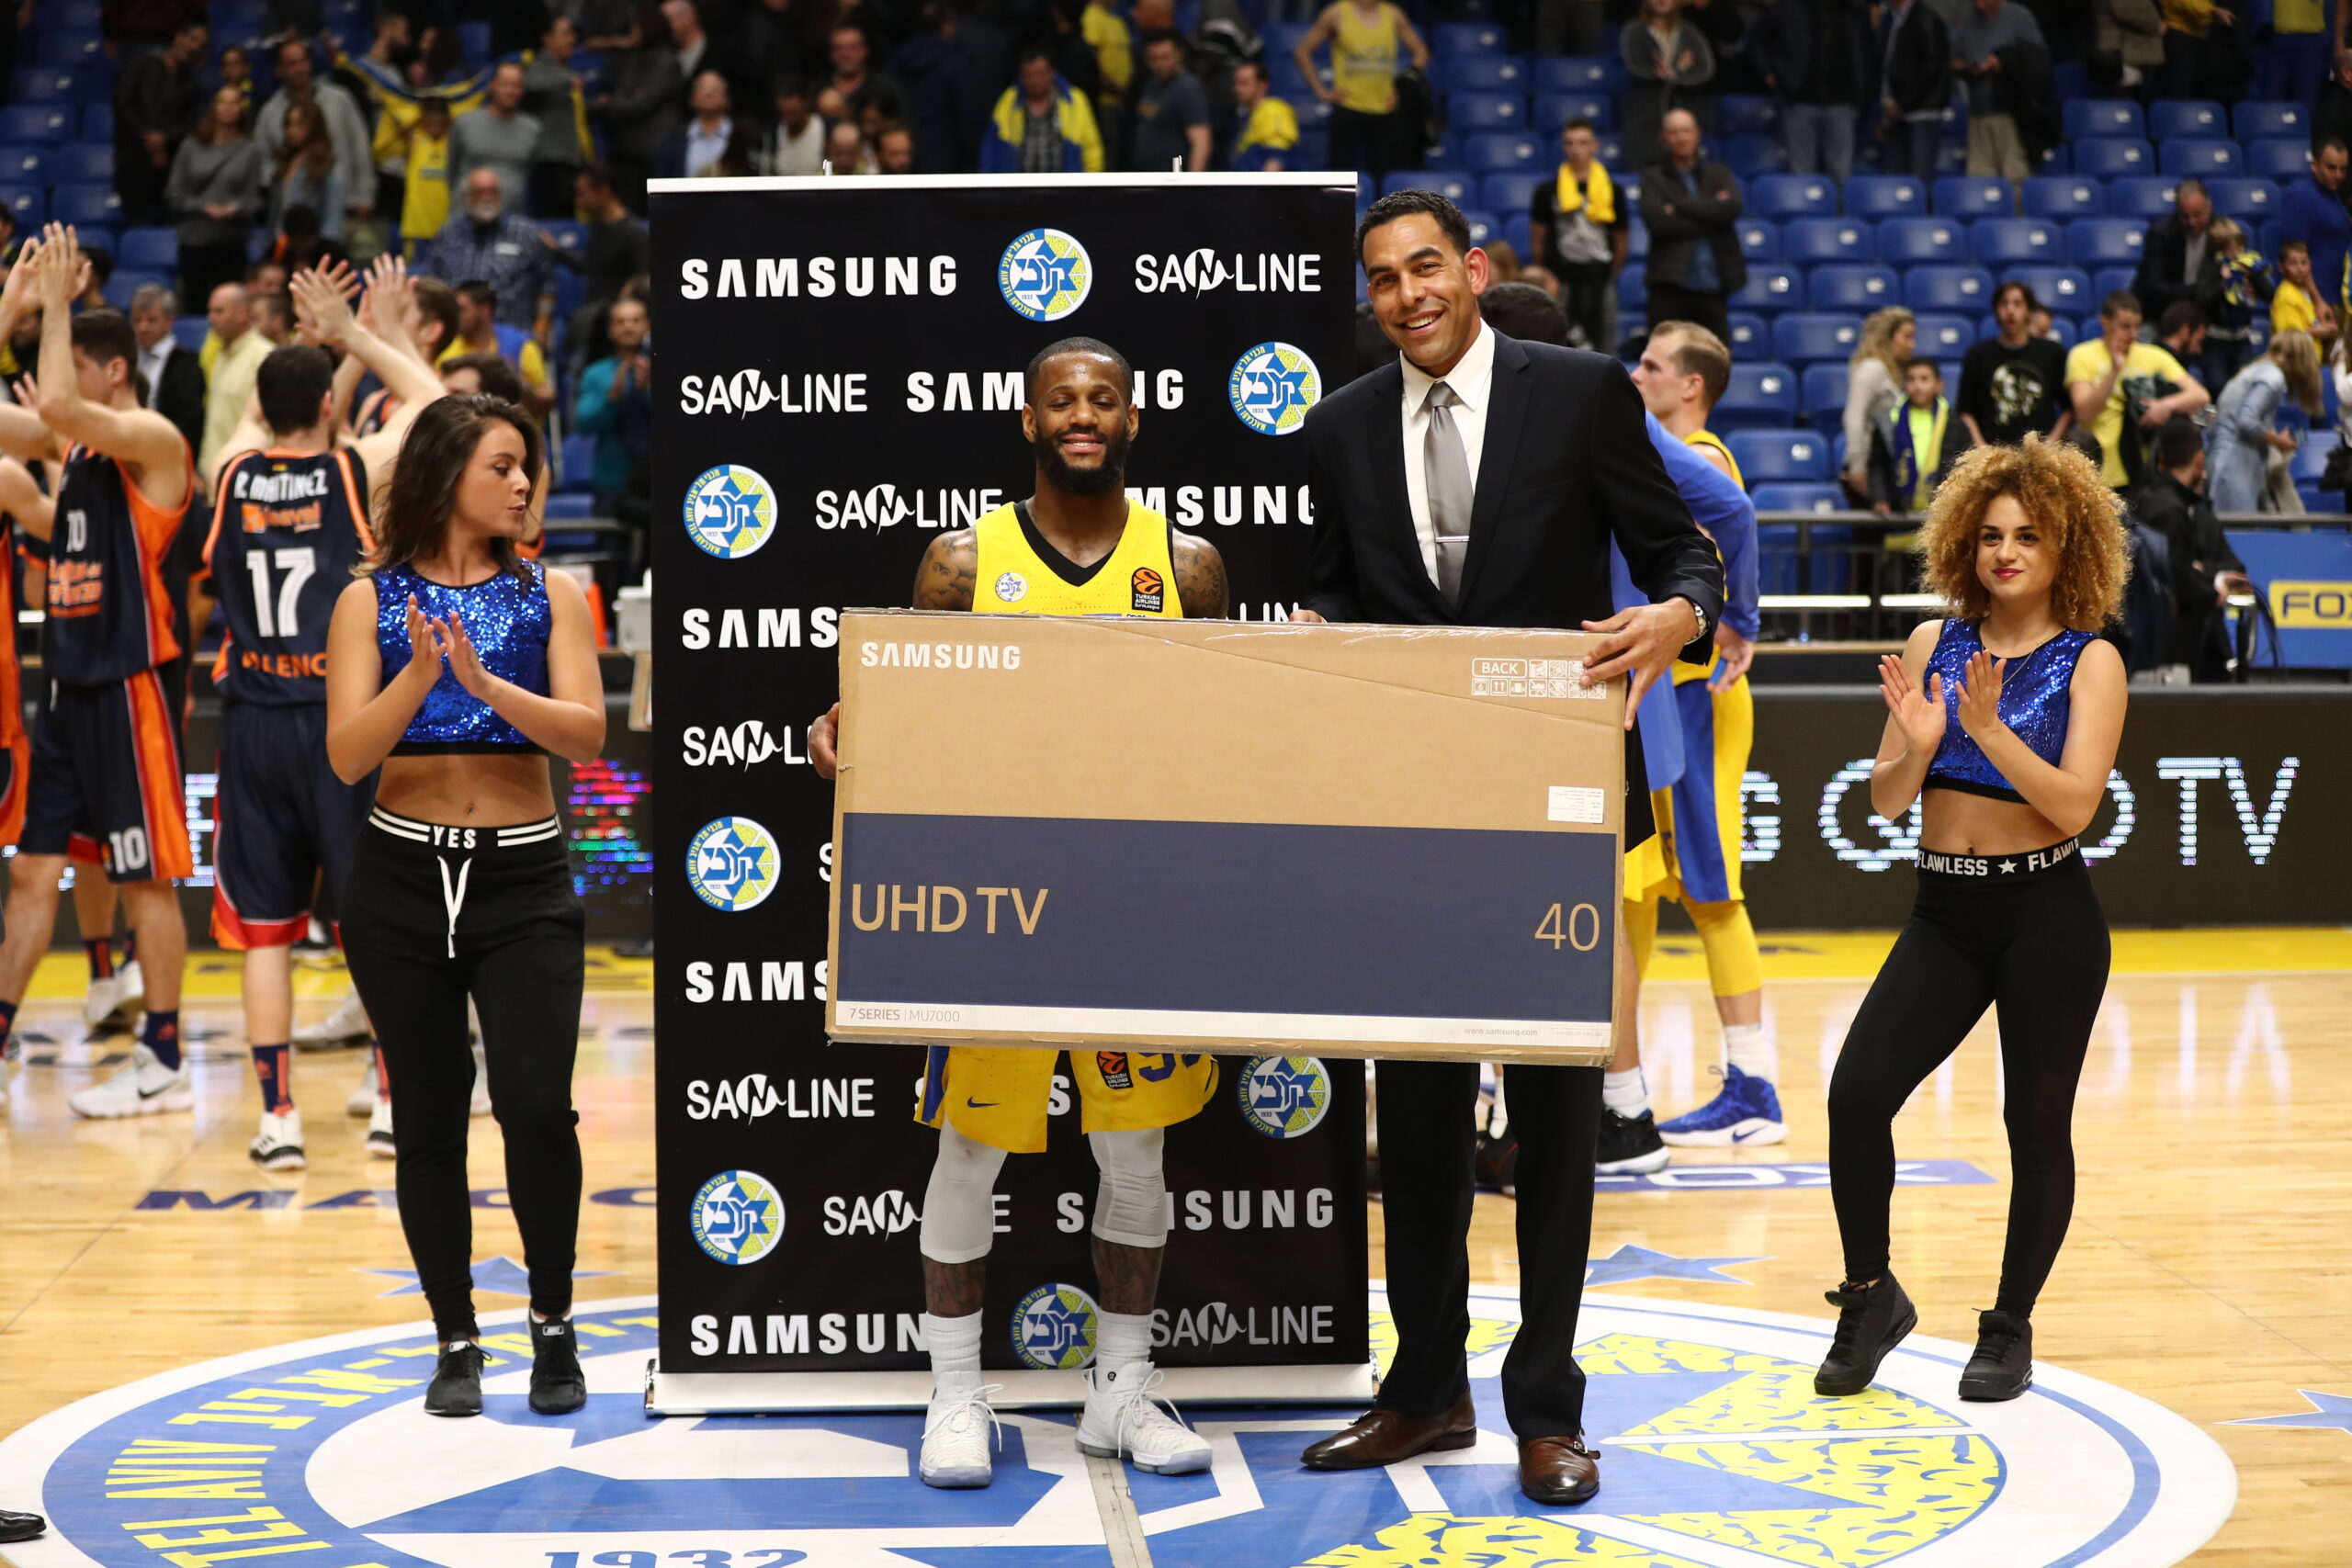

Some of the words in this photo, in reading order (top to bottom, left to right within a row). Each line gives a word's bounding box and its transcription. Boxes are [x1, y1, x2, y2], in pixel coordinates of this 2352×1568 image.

[681, 255, 956, 299] SAMSUNG
[907, 368, 1183, 412] SAMG
[1125, 485, 1315, 526] MSUNG
[246, 547, 315, 637] 17
[2282, 591, 2352, 619] FO
[682, 606, 838, 650] SAMS
[861, 641, 1021, 670] SAMSUNG
[1482, 662, 1518, 674] BACK
[2156, 757, 2300, 865] TV
[109, 826, 149, 874] 10
[433, 825, 476, 850] YES
[1917, 851, 1988, 876] FLAWLESS
[852, 884, 967, 933] UHD
[976, 886, 1049, 935] TV
[1534, 903, 1600, 952] 40
[849, 1009, 856, 1019] 7
[859, 1009, 900, 1021] SERIES
[910, 1010, 960, 1022] MU7000
[1464, 1028, 1538, 1037] www.samsung.com
[1057, 1188, 1333, 1233] SSUNG
[691, 1314, 930, 1356] SAMSUN
[106, 1439, 277, 1498] AVIV
